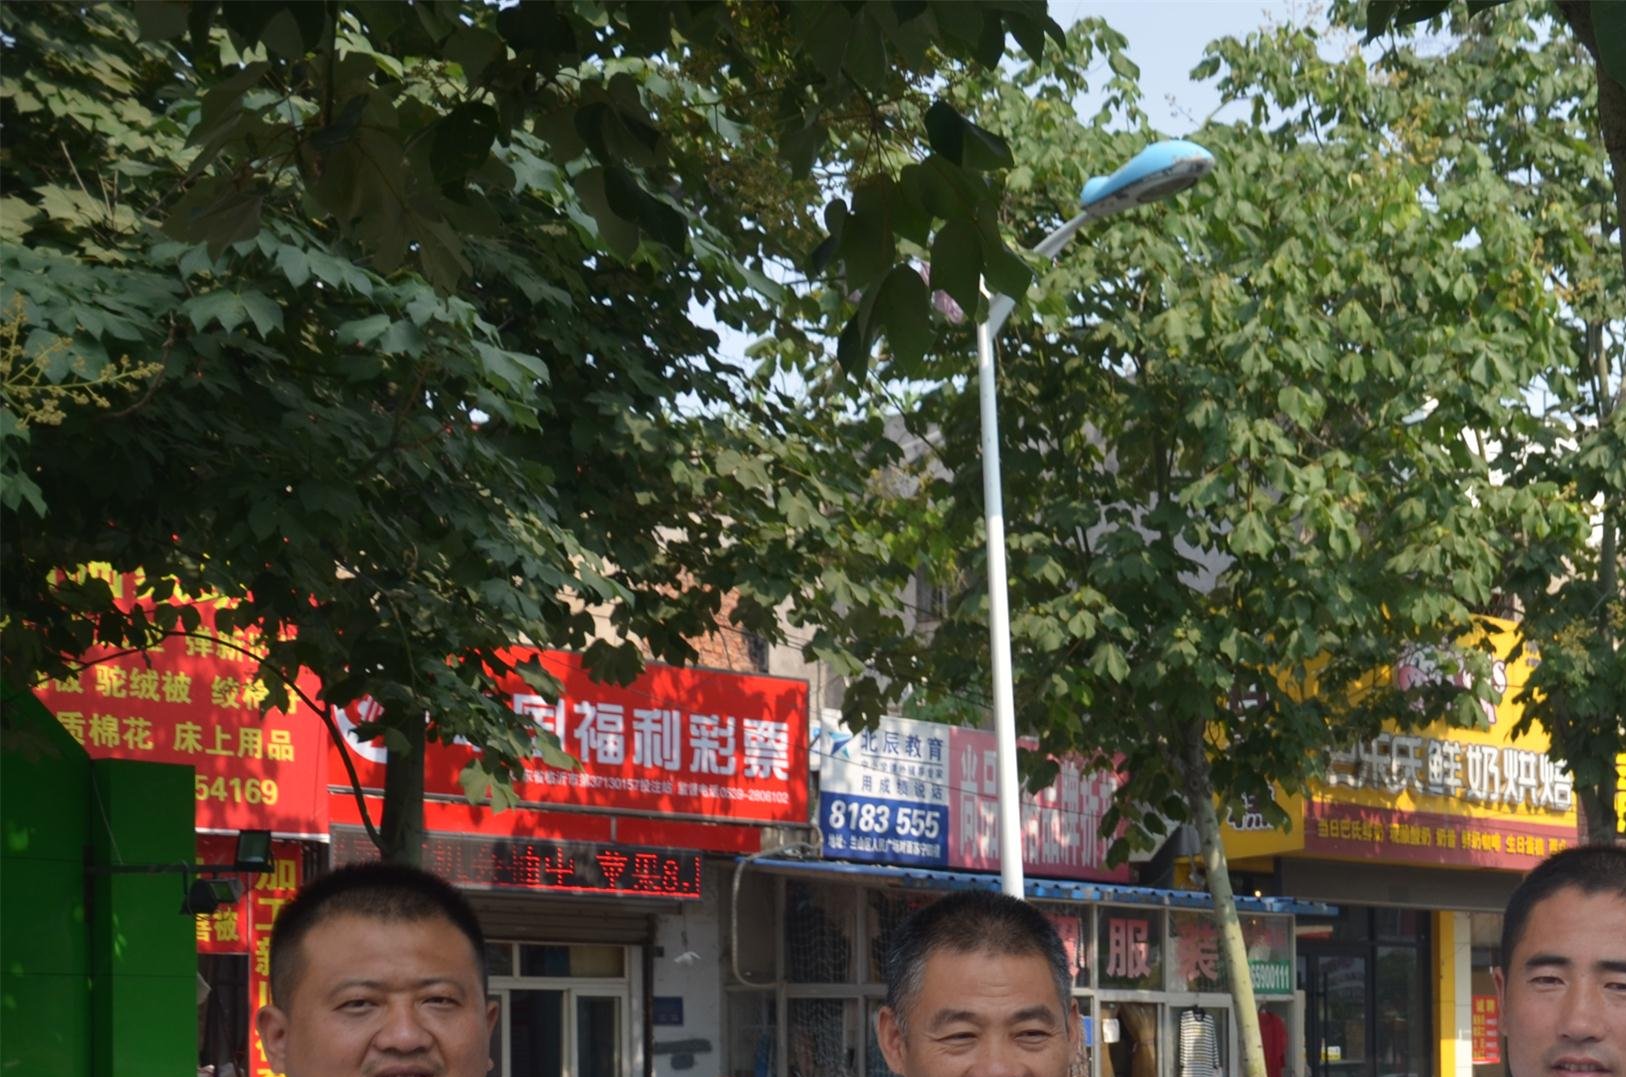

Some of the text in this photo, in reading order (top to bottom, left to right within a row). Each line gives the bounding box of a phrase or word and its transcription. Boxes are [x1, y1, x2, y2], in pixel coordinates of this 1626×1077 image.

[96, 665, 191, 704] 驼绒被
[173, 721, 295, 762] 床上用品
[455, 690, 789, 781] 国福利彩票
[861, 731, 943, 761] 北辰教育
[829, 800, 940, 839] 8183 555
